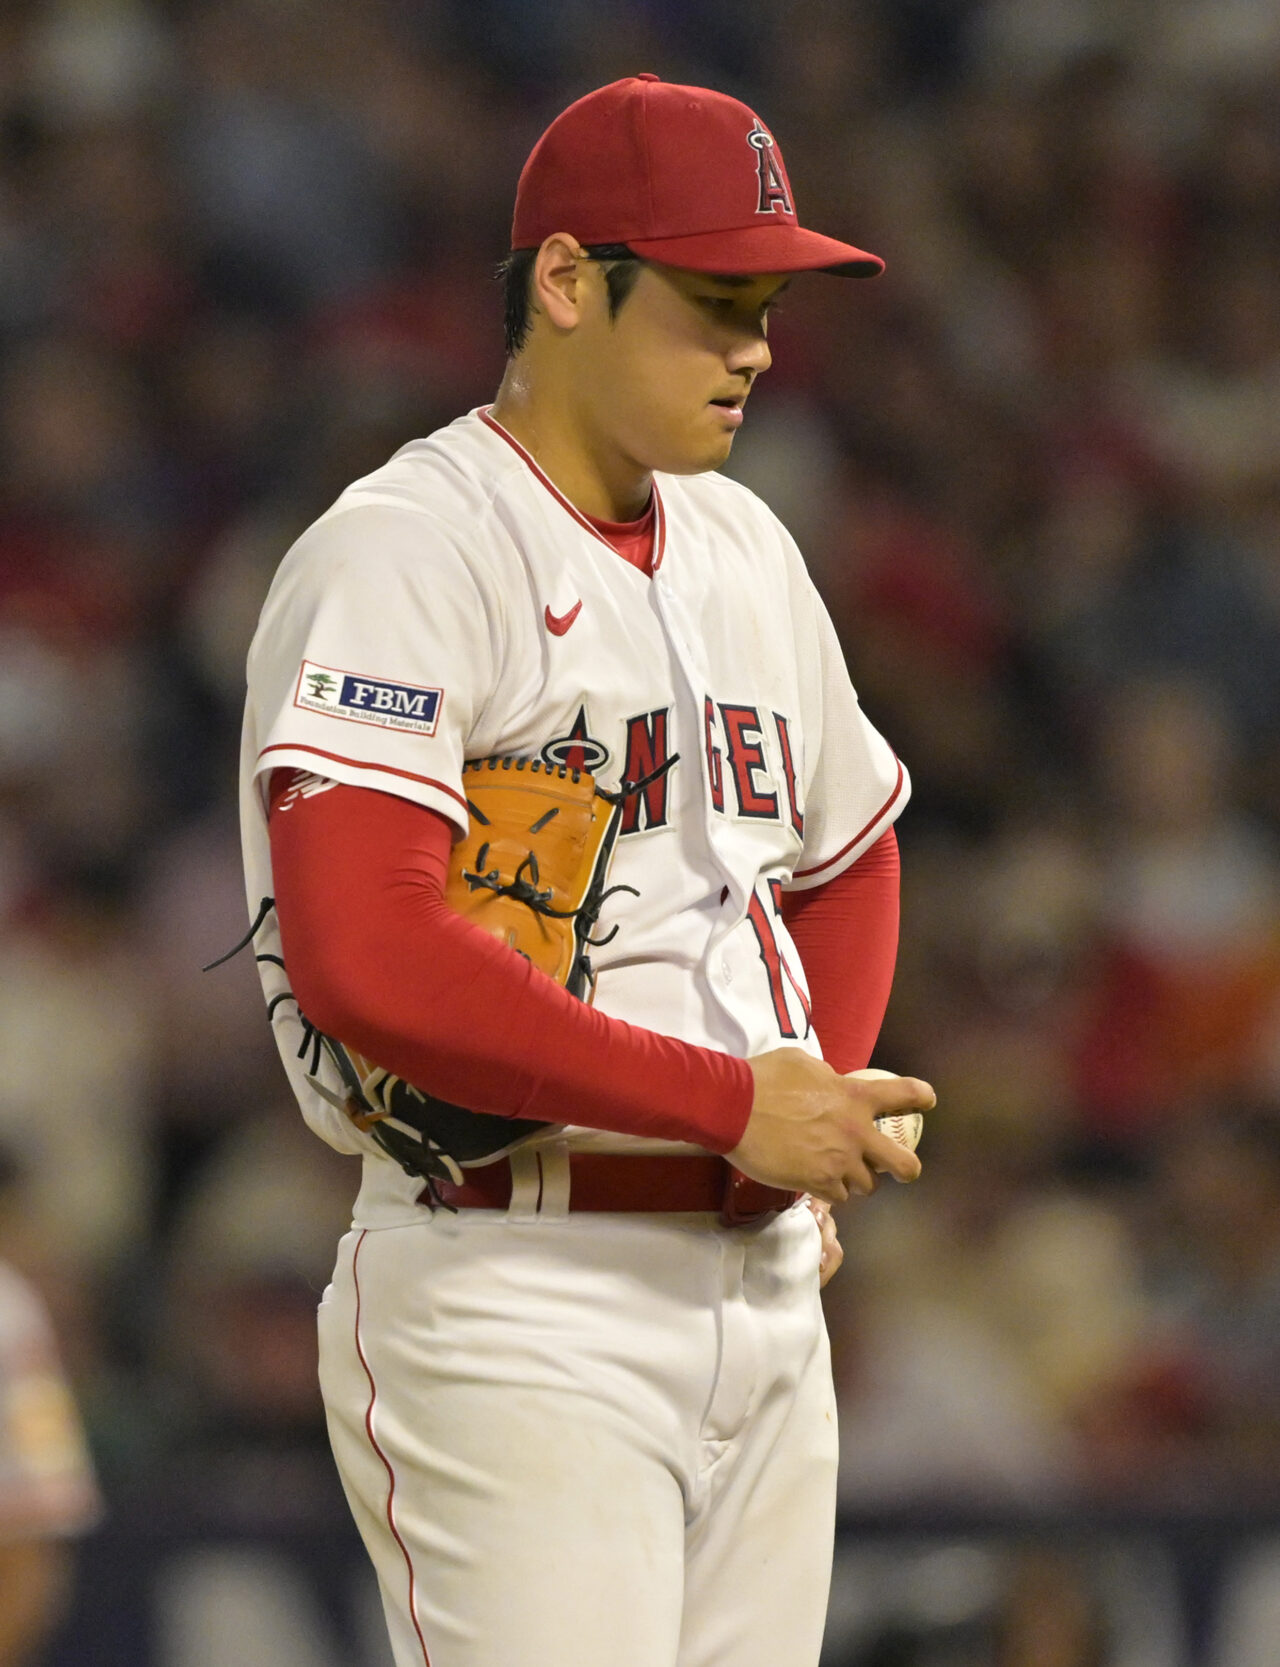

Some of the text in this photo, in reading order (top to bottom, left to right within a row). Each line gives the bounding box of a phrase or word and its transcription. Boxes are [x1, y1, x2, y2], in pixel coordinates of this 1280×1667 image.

[747, 118, 794, 215] A
[299, 696, 432, 732] Foundation Building Materials
[349, 682, 429, 717] FBM
